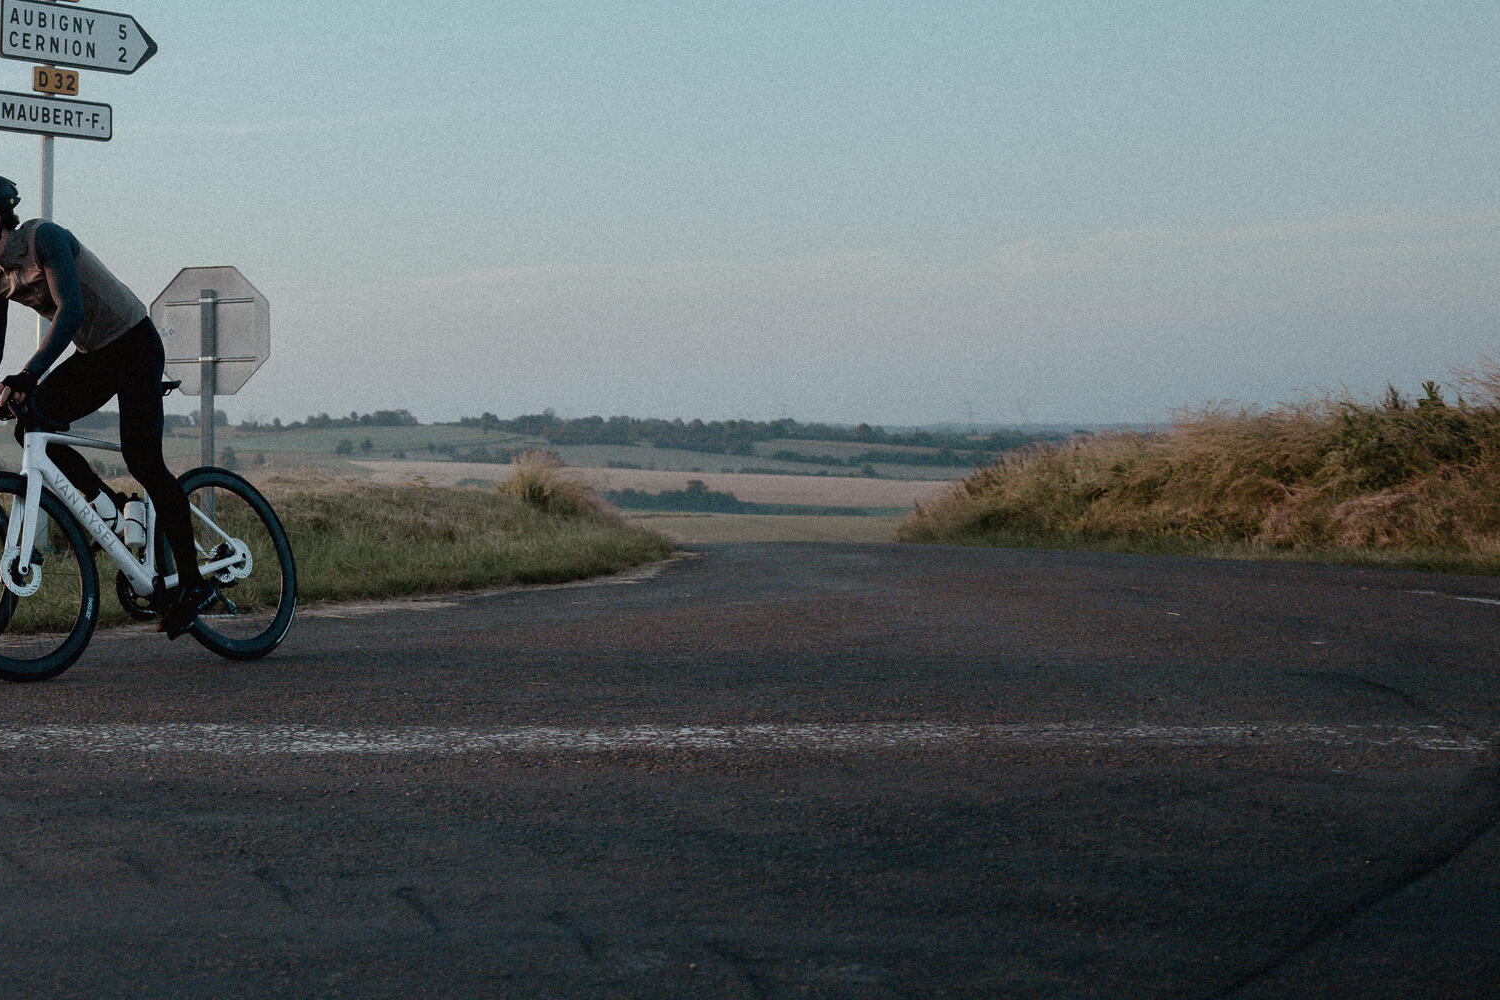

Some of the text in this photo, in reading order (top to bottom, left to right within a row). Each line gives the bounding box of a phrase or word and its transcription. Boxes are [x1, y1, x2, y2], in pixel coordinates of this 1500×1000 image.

[10, 7, 127, 40] AUBIGNY 5
[9, 31, 127, 63] CERNION 2
[1, 102, 105, 131] MAUBERT-F.
[54, 473, 116, 552] VAN RYSEL
